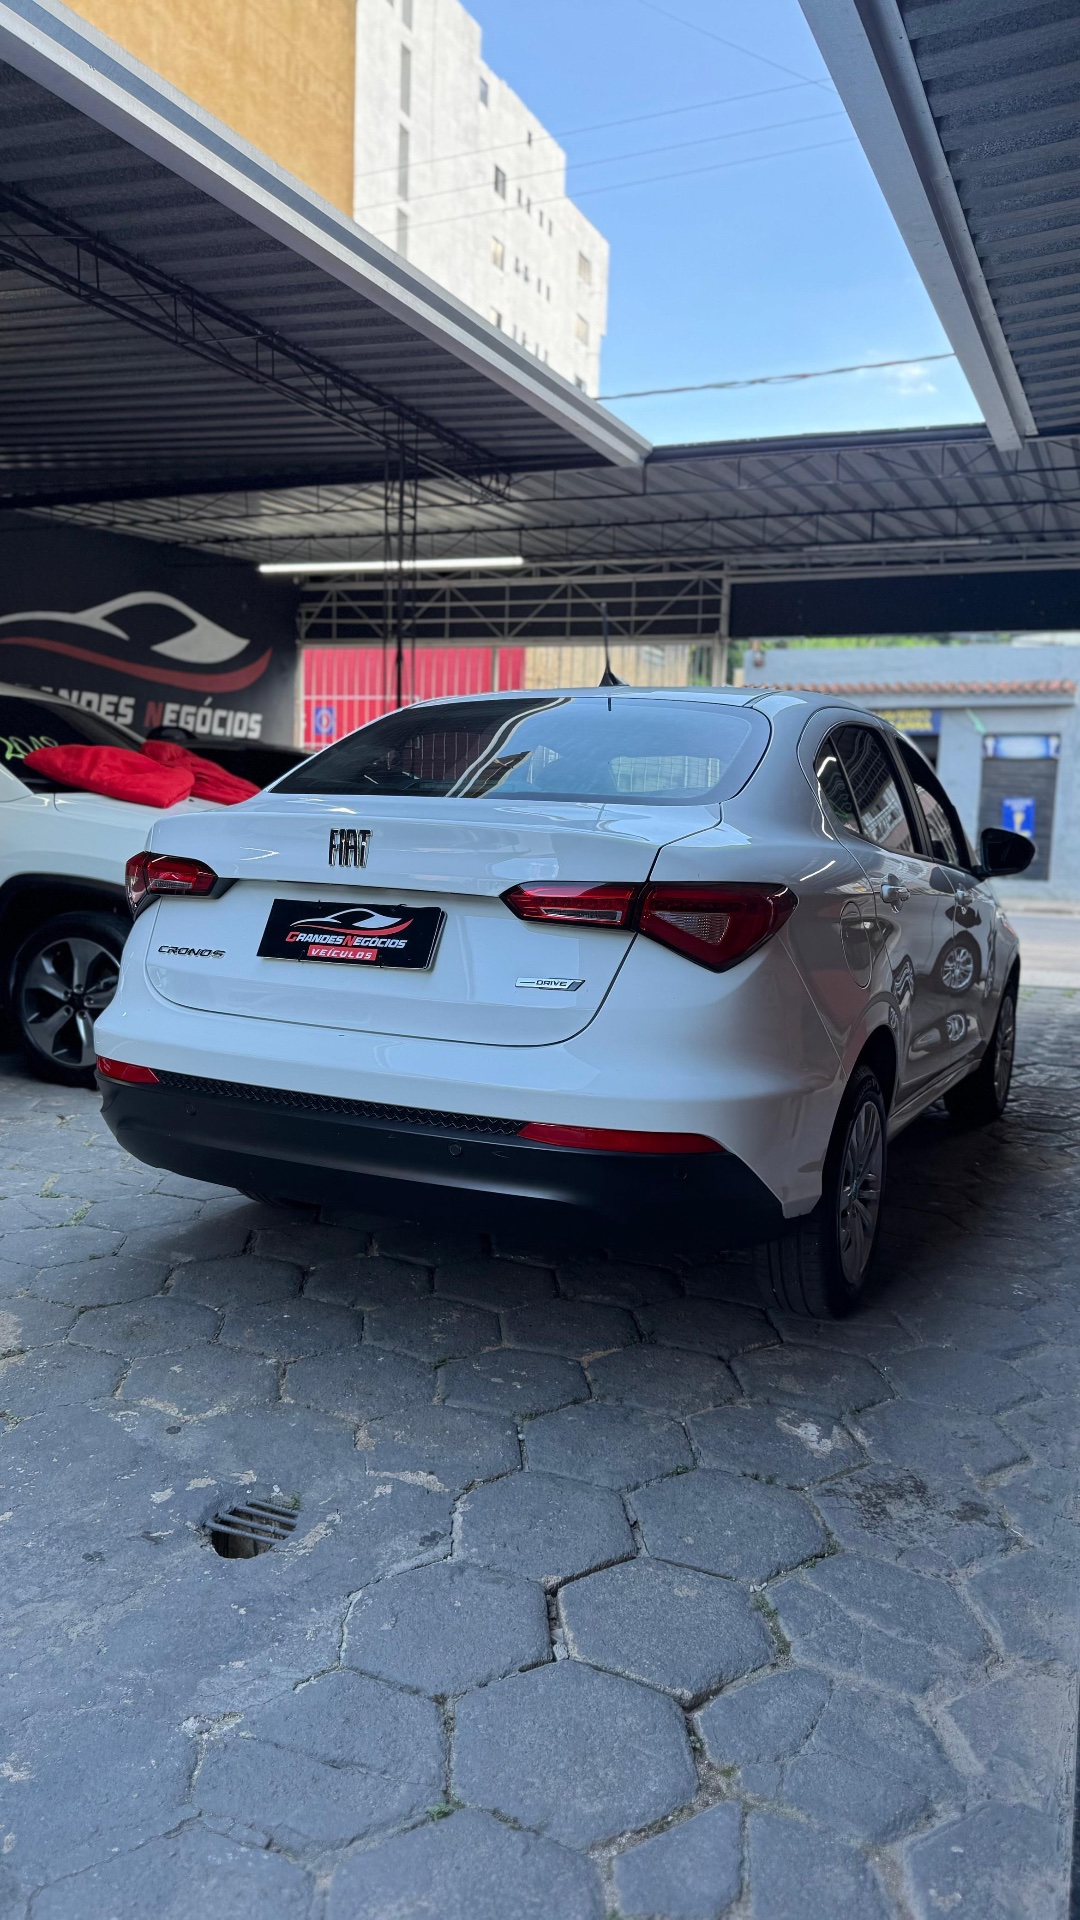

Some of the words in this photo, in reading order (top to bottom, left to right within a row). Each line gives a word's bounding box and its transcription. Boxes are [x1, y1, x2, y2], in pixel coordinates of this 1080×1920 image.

[144, 697, 263, 740] NEGÓCIOS
[328, 828, 373, 868] FIAT
[286, 931, 345, 945] GRANDES
[341, 935, 408, 949] NEGÓCIOS
[158, 945, 226, 959] CRONOS
[311, 947, 374, 960] VEÍCULOS
[535, 979, 568, 987] DRIVE
